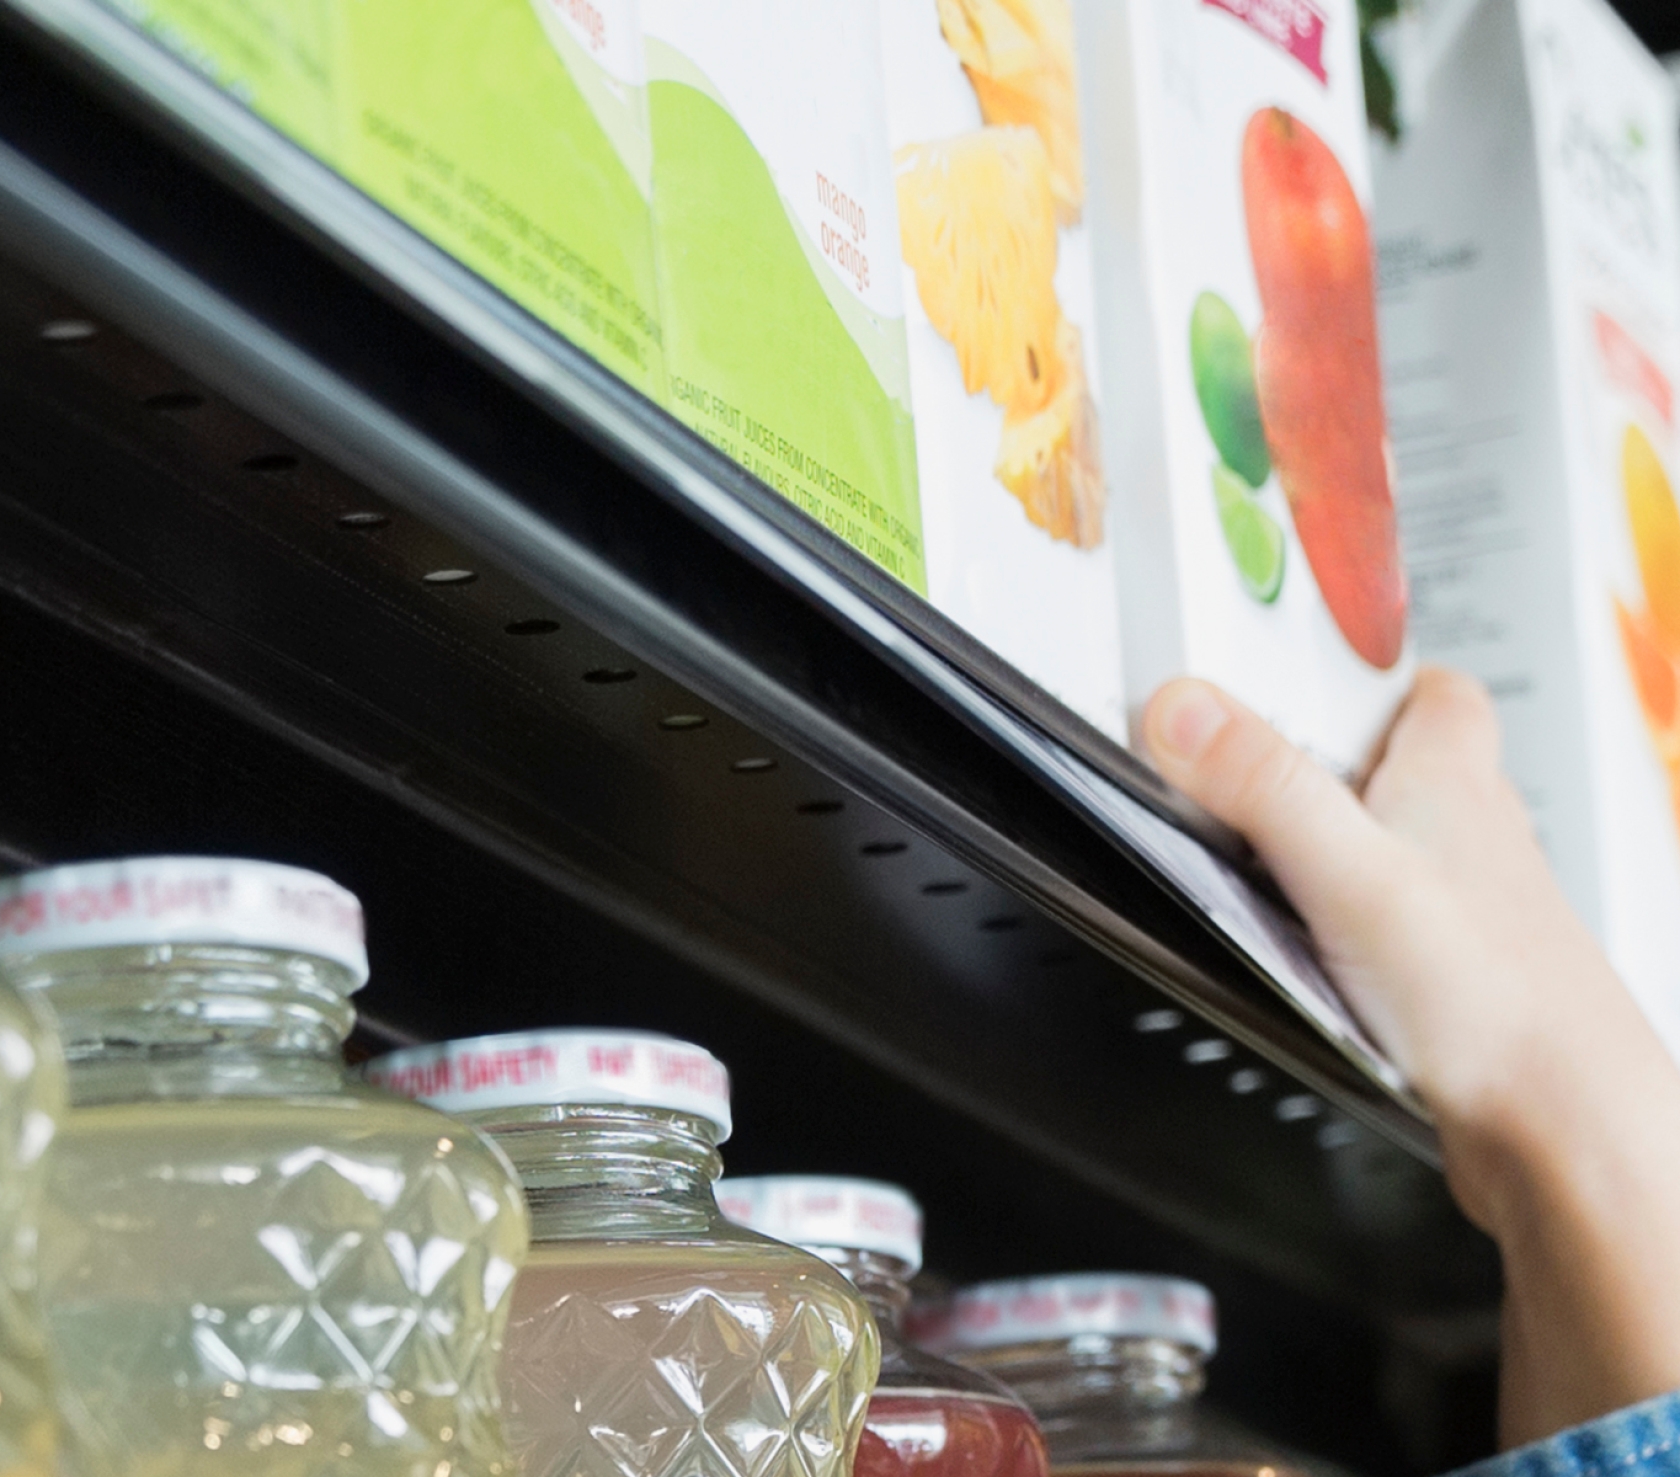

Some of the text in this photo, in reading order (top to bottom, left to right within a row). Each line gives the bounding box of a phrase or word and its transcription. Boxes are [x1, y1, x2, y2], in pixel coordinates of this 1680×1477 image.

[815, 170, 867, 244] mango
[821, 221, 870, 293] orange
[711, 395, 741, 433] FRUIT
[743, 415, 776, 457] JUICES
[777, 436, 804, 476] FROM
[805, 456, 868, 518] CONCENTRATE
